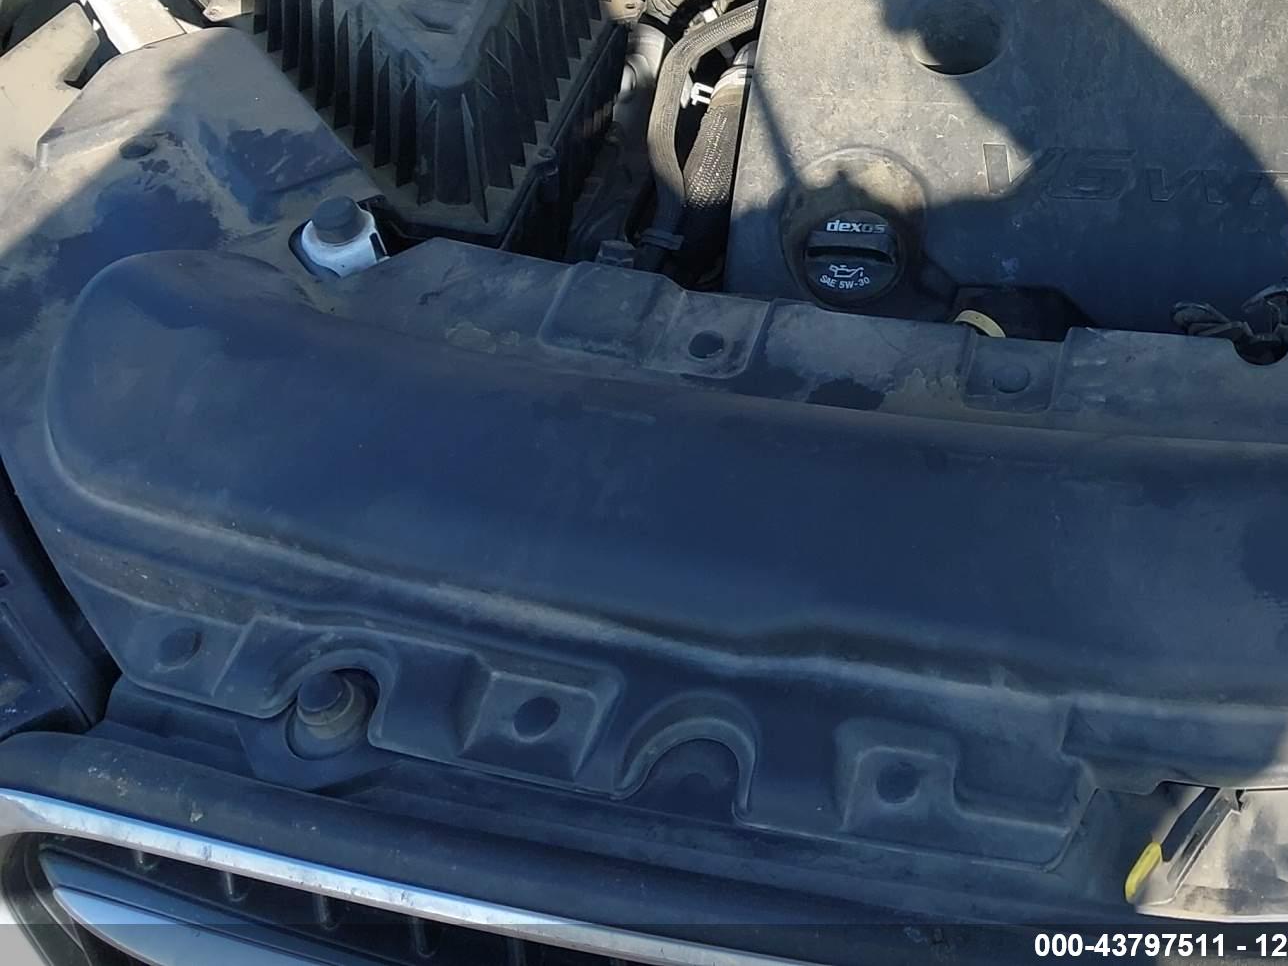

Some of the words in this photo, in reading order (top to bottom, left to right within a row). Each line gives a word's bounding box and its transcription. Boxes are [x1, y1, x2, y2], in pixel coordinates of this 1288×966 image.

[826, 219, 887, 233] dexos
[820, 274, 837, 288] SAE
[839, 276, 870, 289] 5W-30
